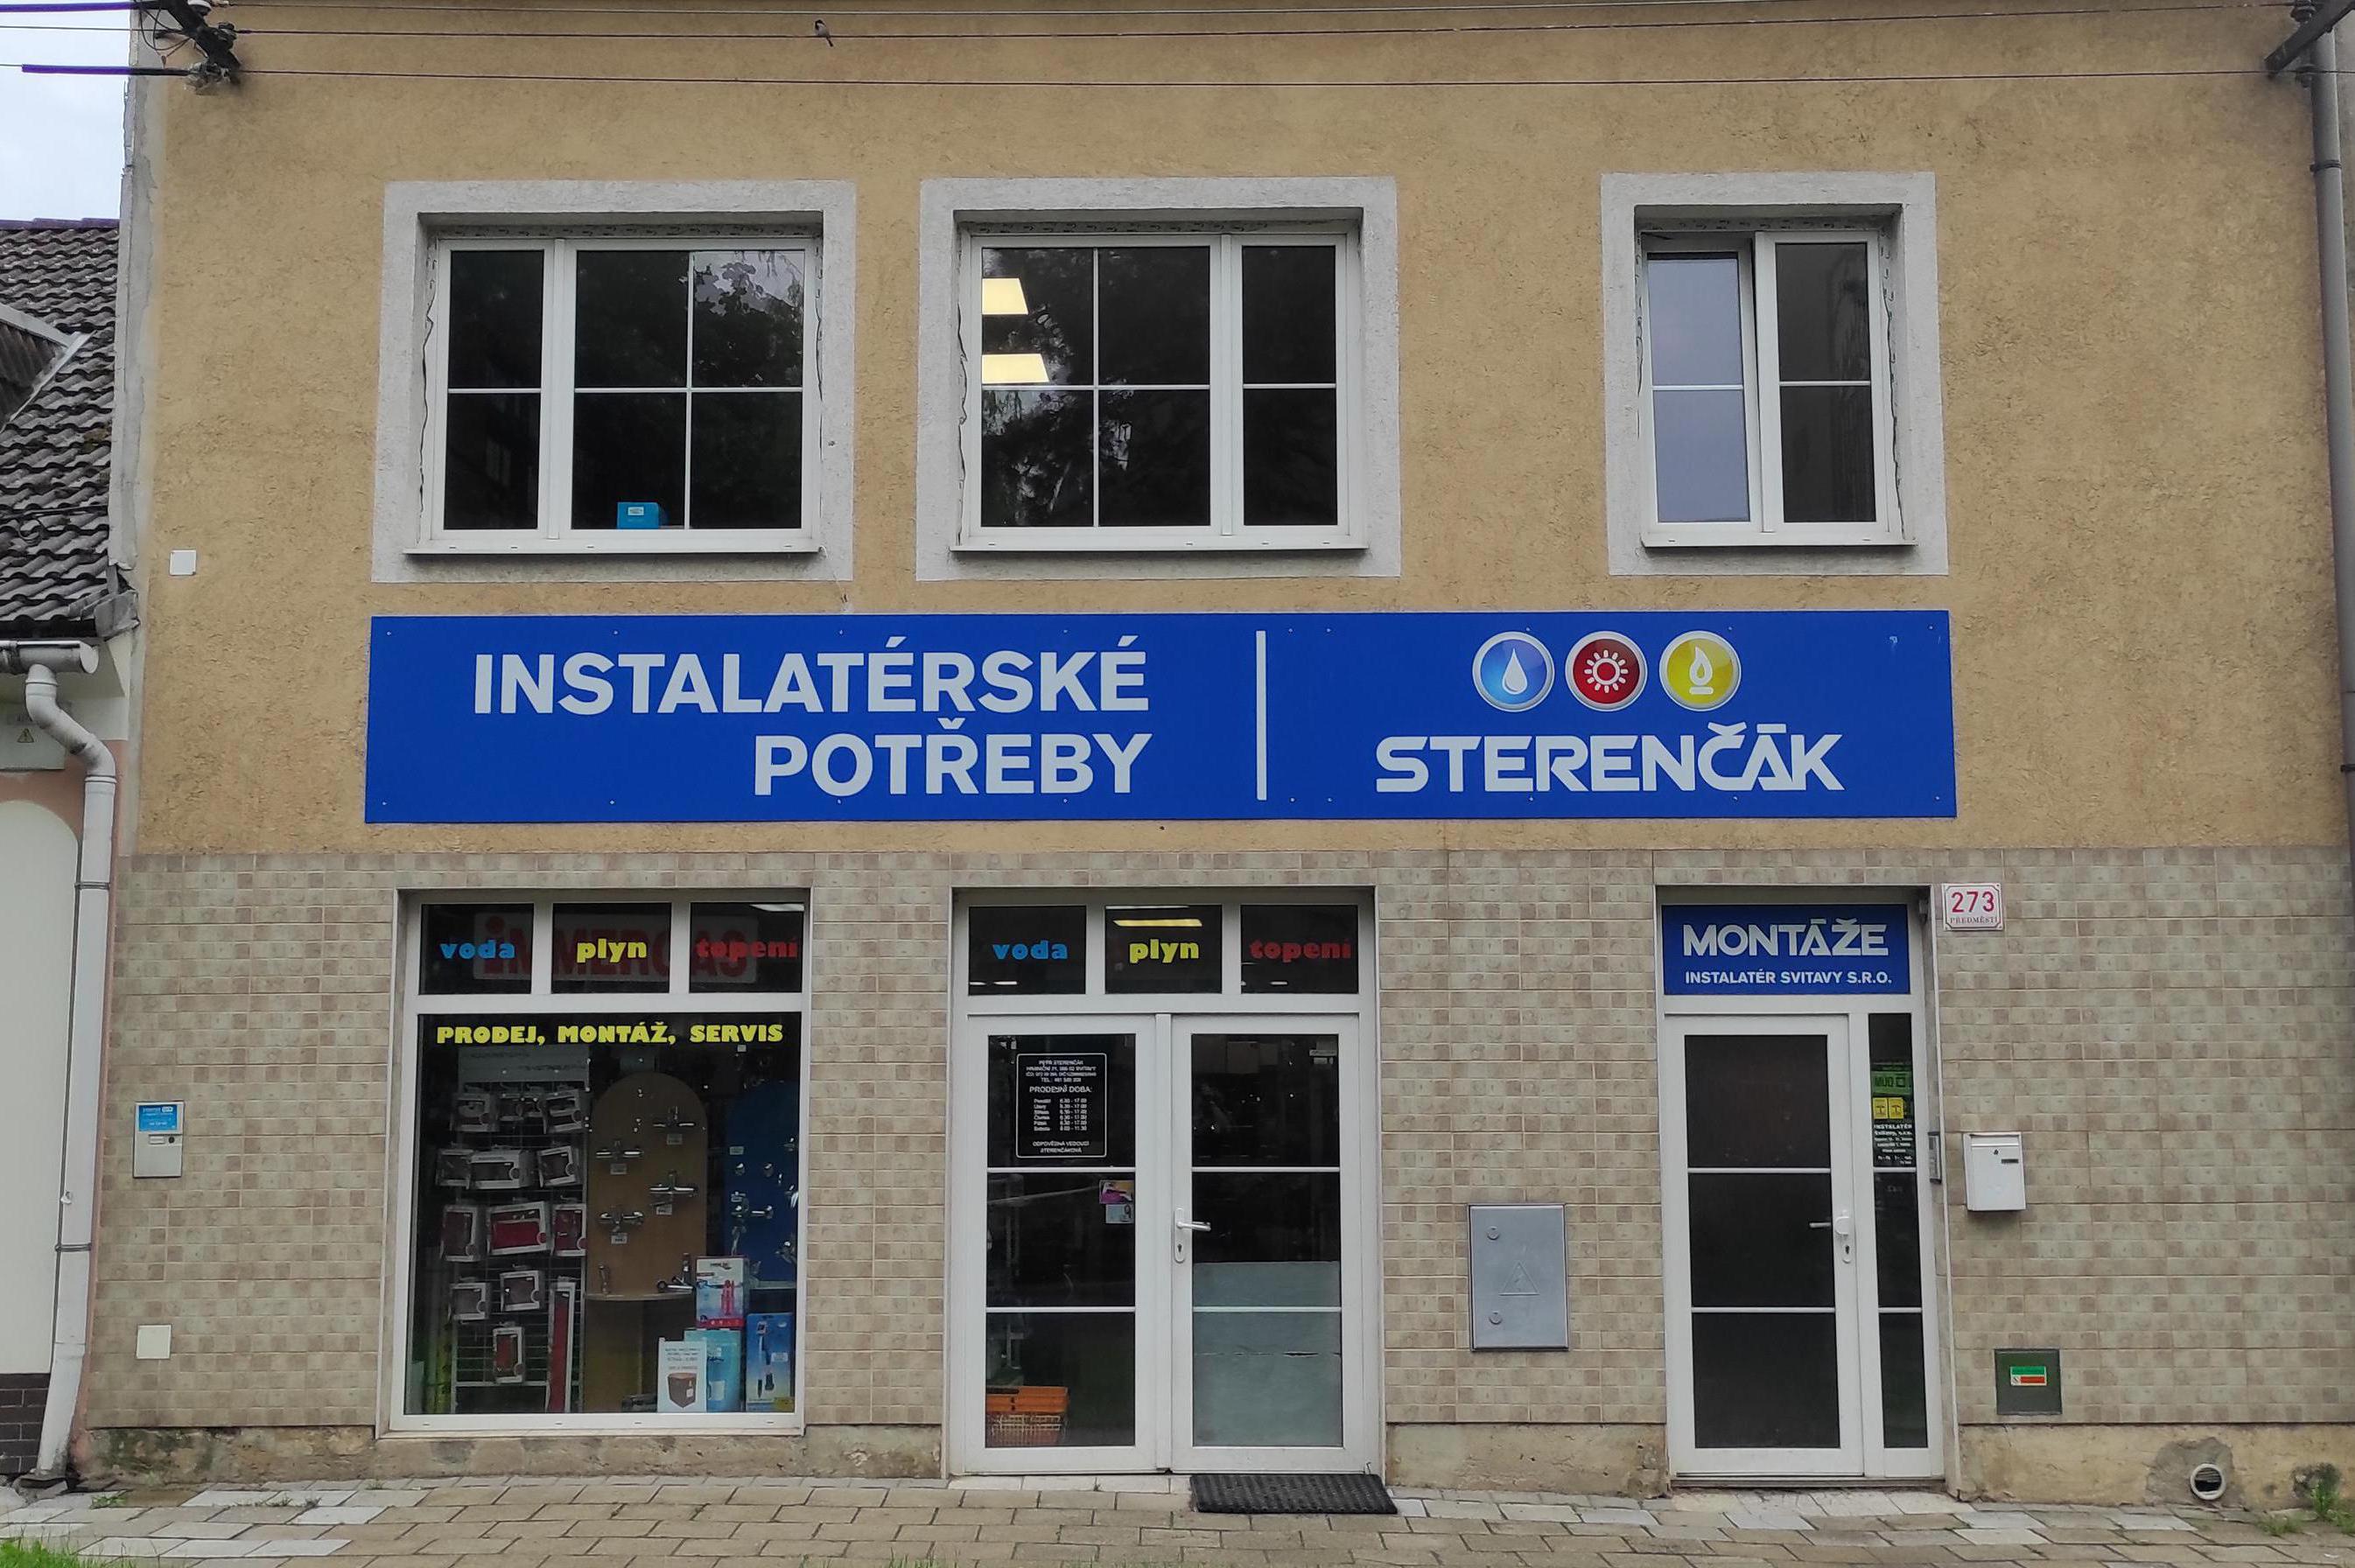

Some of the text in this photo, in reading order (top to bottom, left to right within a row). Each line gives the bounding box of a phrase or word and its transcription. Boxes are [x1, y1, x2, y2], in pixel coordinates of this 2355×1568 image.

[473, 635, 1150, 715] INSTALATÉRSKÉ
[753, 718, 1153, 796] POTŘEBY
[1951, 890, 1995, 914] 273
[439, 939, 516, 960] voda
[576, 938, 648, 963] plyn
[992, 939, 1069, 961] voda
[1129, 939, 1200, 963] plyn
[1685, 969, 1893, 984] INSTALATÉR SVITAVY S.R.O.
[437, 1022, 783, 1045] PRODEJ, MONTÁŽ, SERVIS
